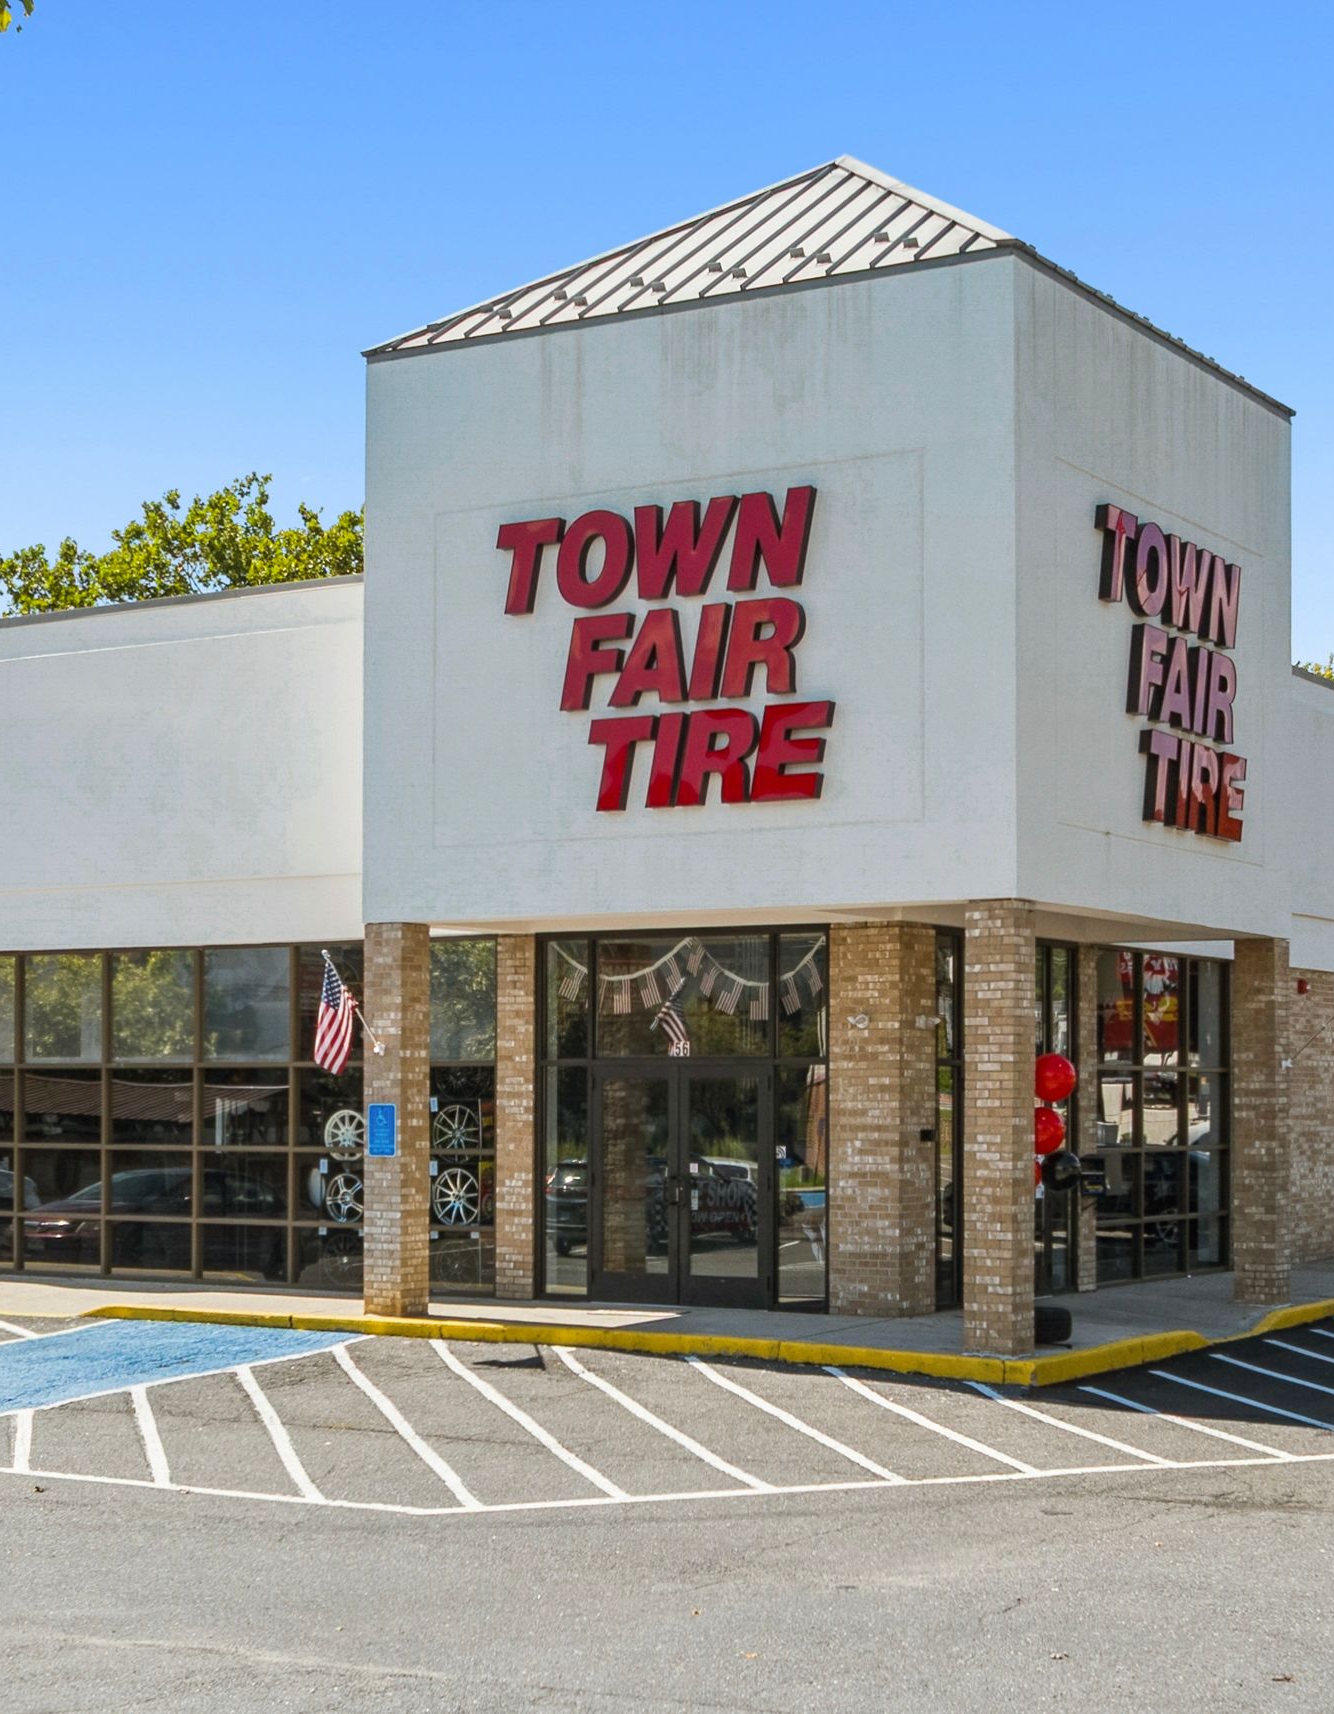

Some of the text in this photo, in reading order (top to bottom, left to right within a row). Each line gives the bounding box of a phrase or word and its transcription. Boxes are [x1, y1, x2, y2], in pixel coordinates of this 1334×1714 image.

[496, 485, 818, 615] TOWN
[1094, 503, 1241, 649] TOWN
[560, 597, 806, 711] FAIR
[1126, 623, 1237, 744] FAIR
[588, 700, 836, 812] TIRE
[1138, 729, 1247, 842] TIRE
[674, 1042, 688, 1056] 56
